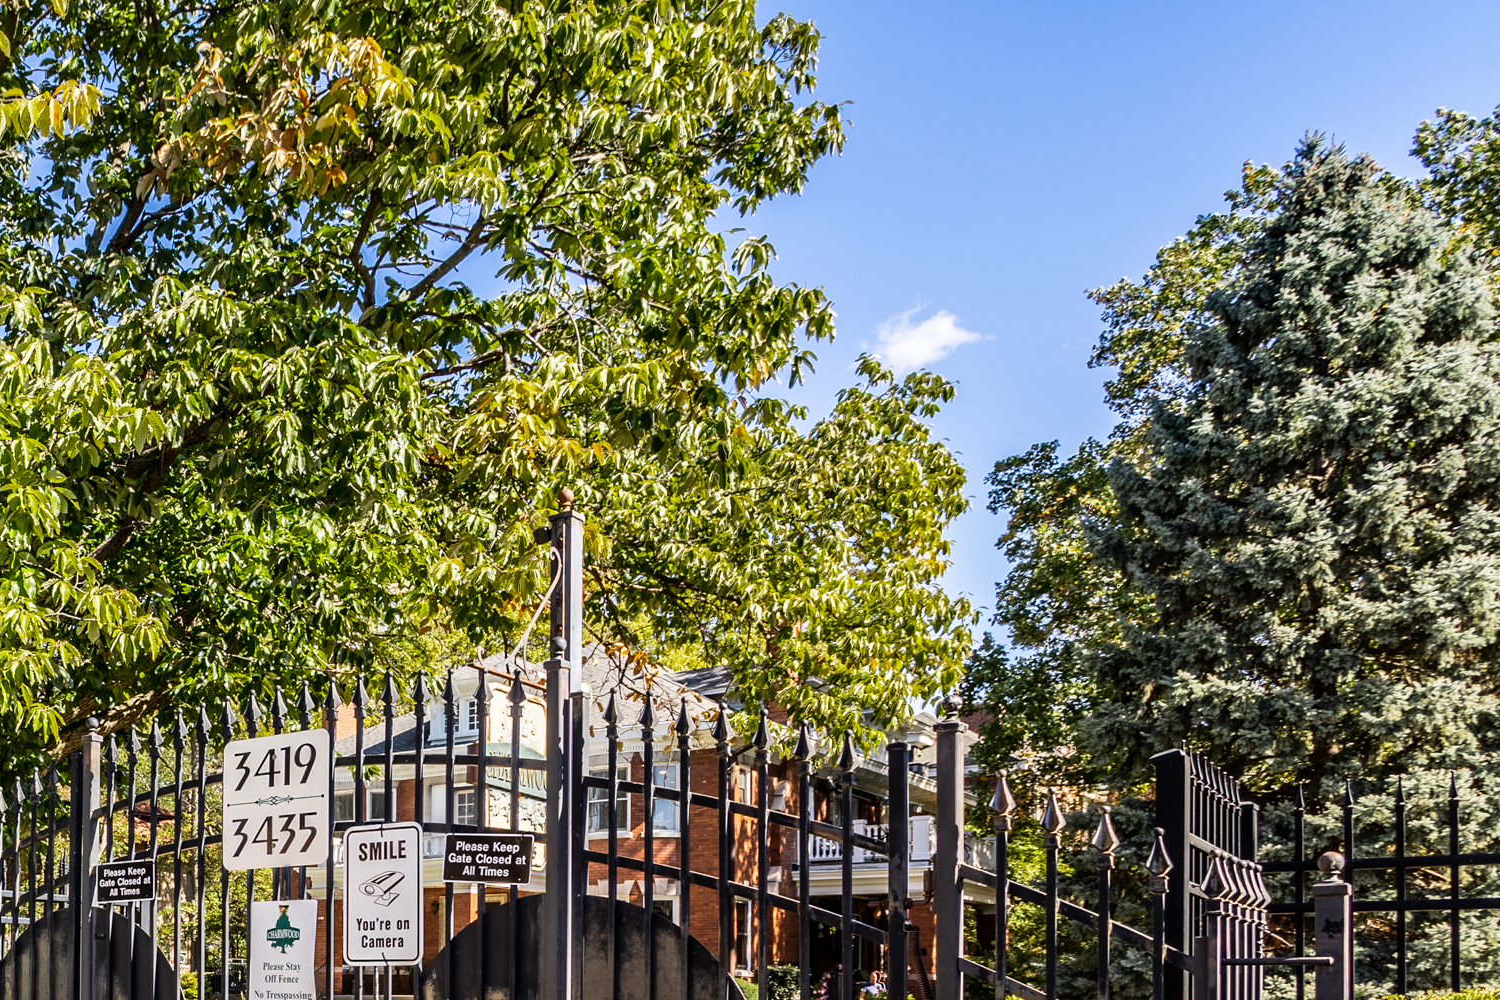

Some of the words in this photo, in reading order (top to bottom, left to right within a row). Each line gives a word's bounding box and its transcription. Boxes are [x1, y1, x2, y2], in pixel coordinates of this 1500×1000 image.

[235, 743, 317, 792] 3419
[232, 812, 318, 858] 3435
[358, 840, 407, 862] SMILE
[456, 841, 489, 852] Please
[493, 841, 520, 855] Keep
[448, 853, 472, 864] Gate
[475, 853, 512, 865] Closed
[515, 855, 527, 865] at
[103, 868, 126, 878] Please
[127, 866, 146, 876] Keep
[462, 865, 476, 876] All
[478, 866, 510, 877] Times
[99, 879, 116, 888] Gate
[117, 876, 142, 887] Closed
[143, 876, 151, 885] at
[109, 887, 118, 897] All
[119, 887, 141, 896] Times
[356, 917, 391, 931] You're
[396, 919, 410, 931] on
[267, 928, 300, 939] CHARMWOOD
[361, 935, 404, 948] Camera
[263, 961, 284, 971] Please
[285, 961, 302, 973] Stay
[264, 974, 277, 983] Off
[278, 974, 299, 983] Fence
[254, 990, 264, 999] No
